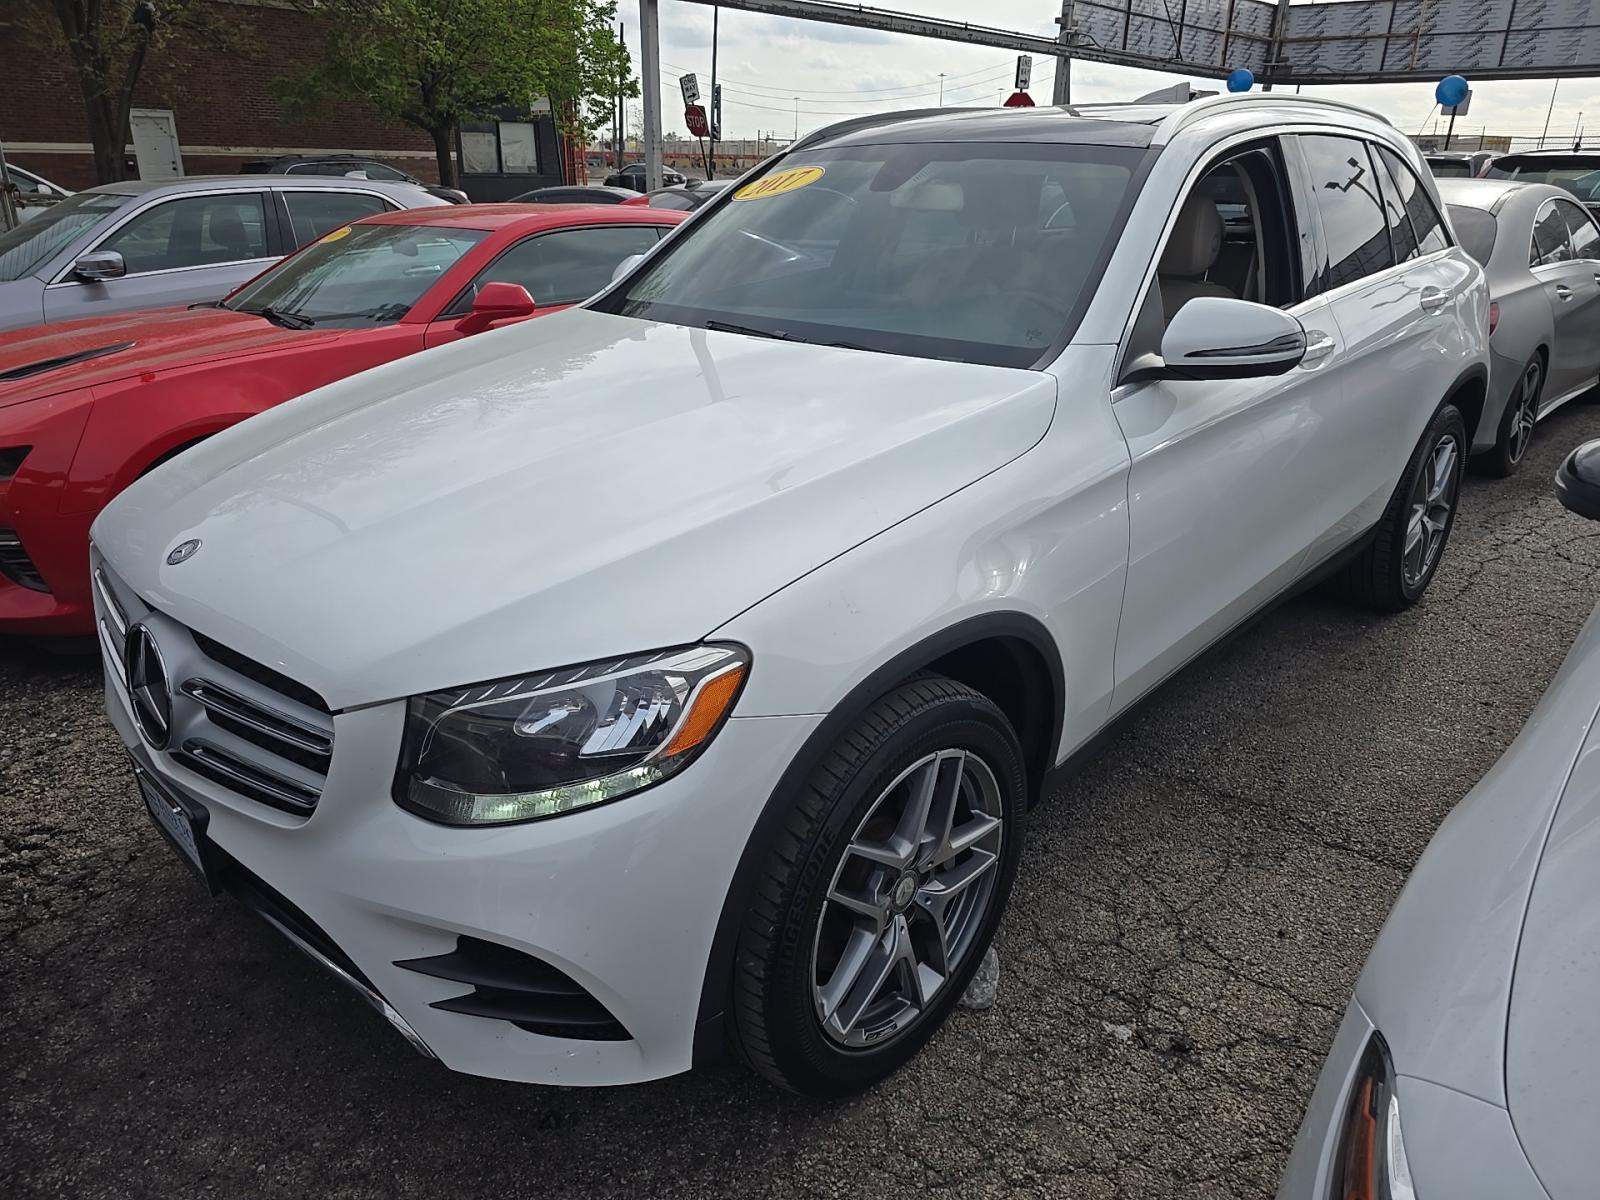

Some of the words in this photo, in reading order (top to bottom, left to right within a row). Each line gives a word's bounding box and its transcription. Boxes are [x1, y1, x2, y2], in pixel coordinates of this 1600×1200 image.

[683, 77, 695, 86] ONE
[685, 83, 697, 92] WAY
[686, 115, 706, 128] STOP
[739, 167, 817, 199] 2017
